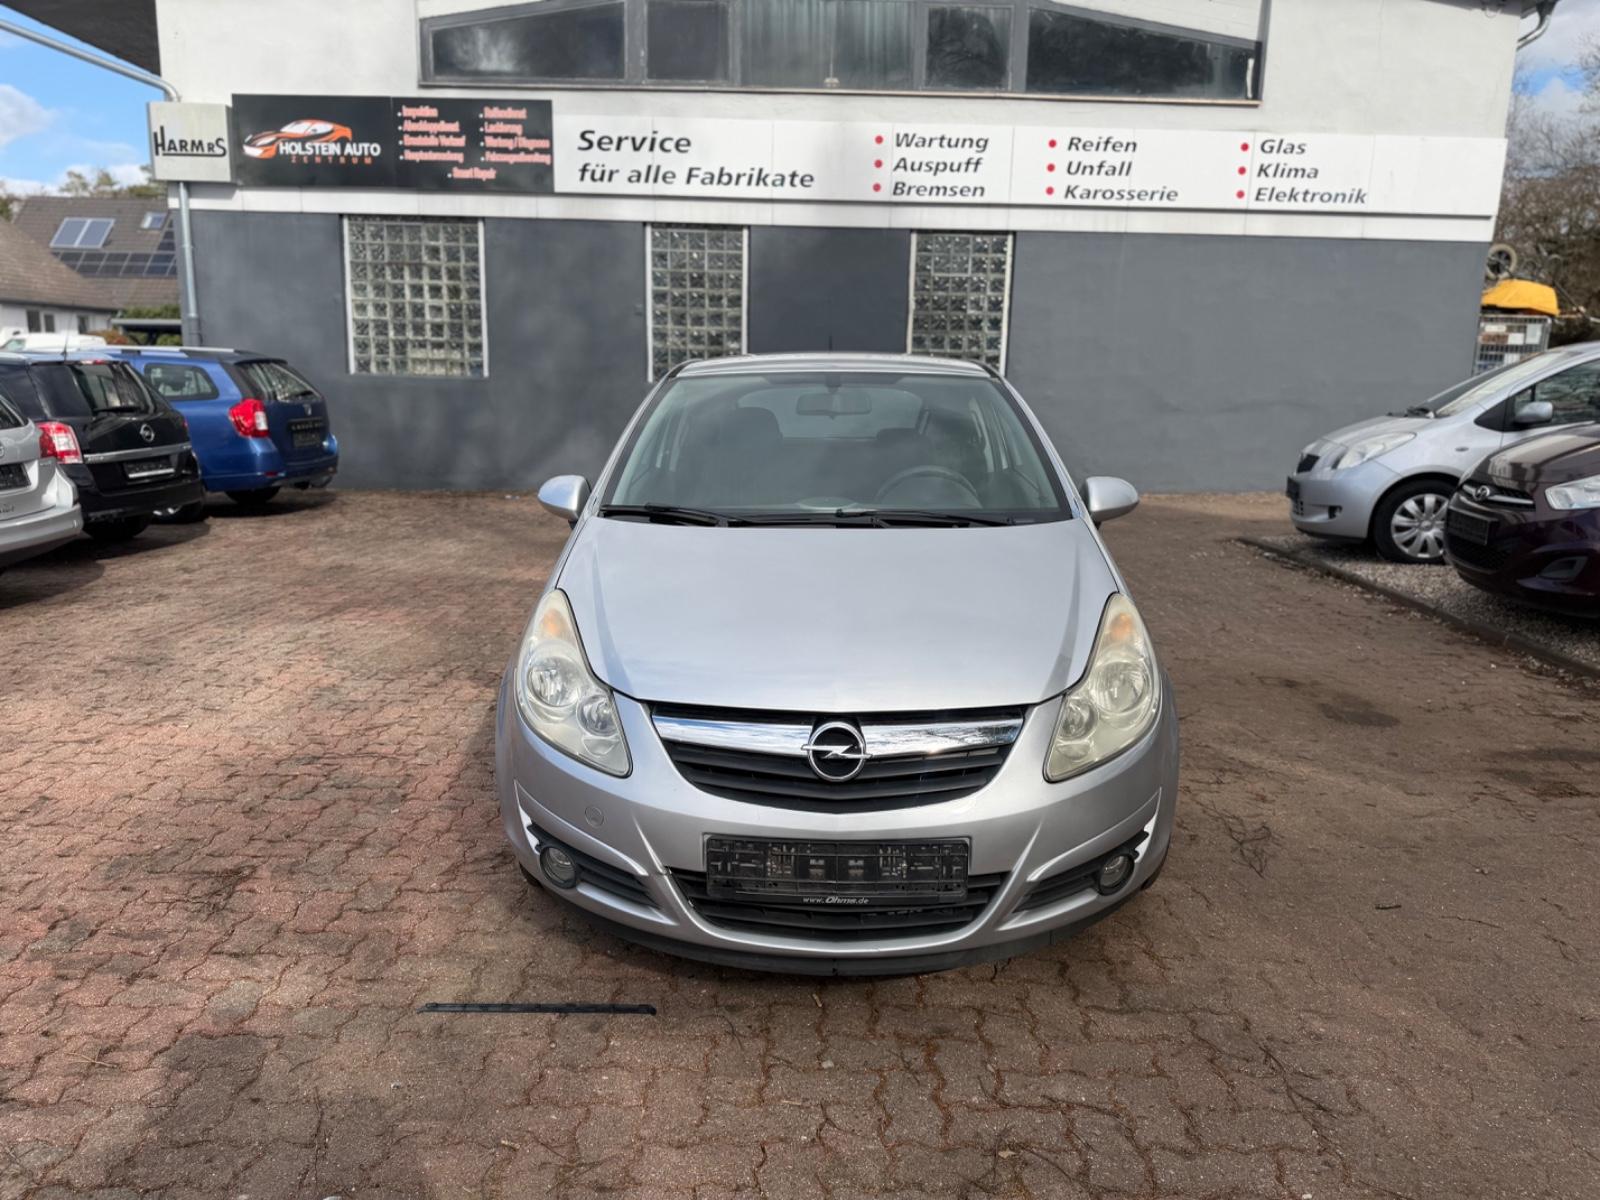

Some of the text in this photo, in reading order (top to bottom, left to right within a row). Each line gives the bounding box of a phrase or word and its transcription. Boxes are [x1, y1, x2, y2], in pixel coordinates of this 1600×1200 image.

[279, 141, 382, 157] HOLSTEIN AUTO
[577, 129, 692, 153] Service
[894, 132, 990, 154] Wartung
[1067, 136, 1138, 153] Reifen
[1259, 138, 1307, 155] Glas
[577, 162, 815, 188] für alle Fabrikate
[892, 156, 983, 177] Auspuff
[1066, 160, 1133, 177] Unfall
[1256, 162, 1319, 179] Klima
[892, 181, 985, 198] Bremsen
[1064, 184, 1179, 202] Karosserie
[1254, 186, 1367, 204] Elektronik
